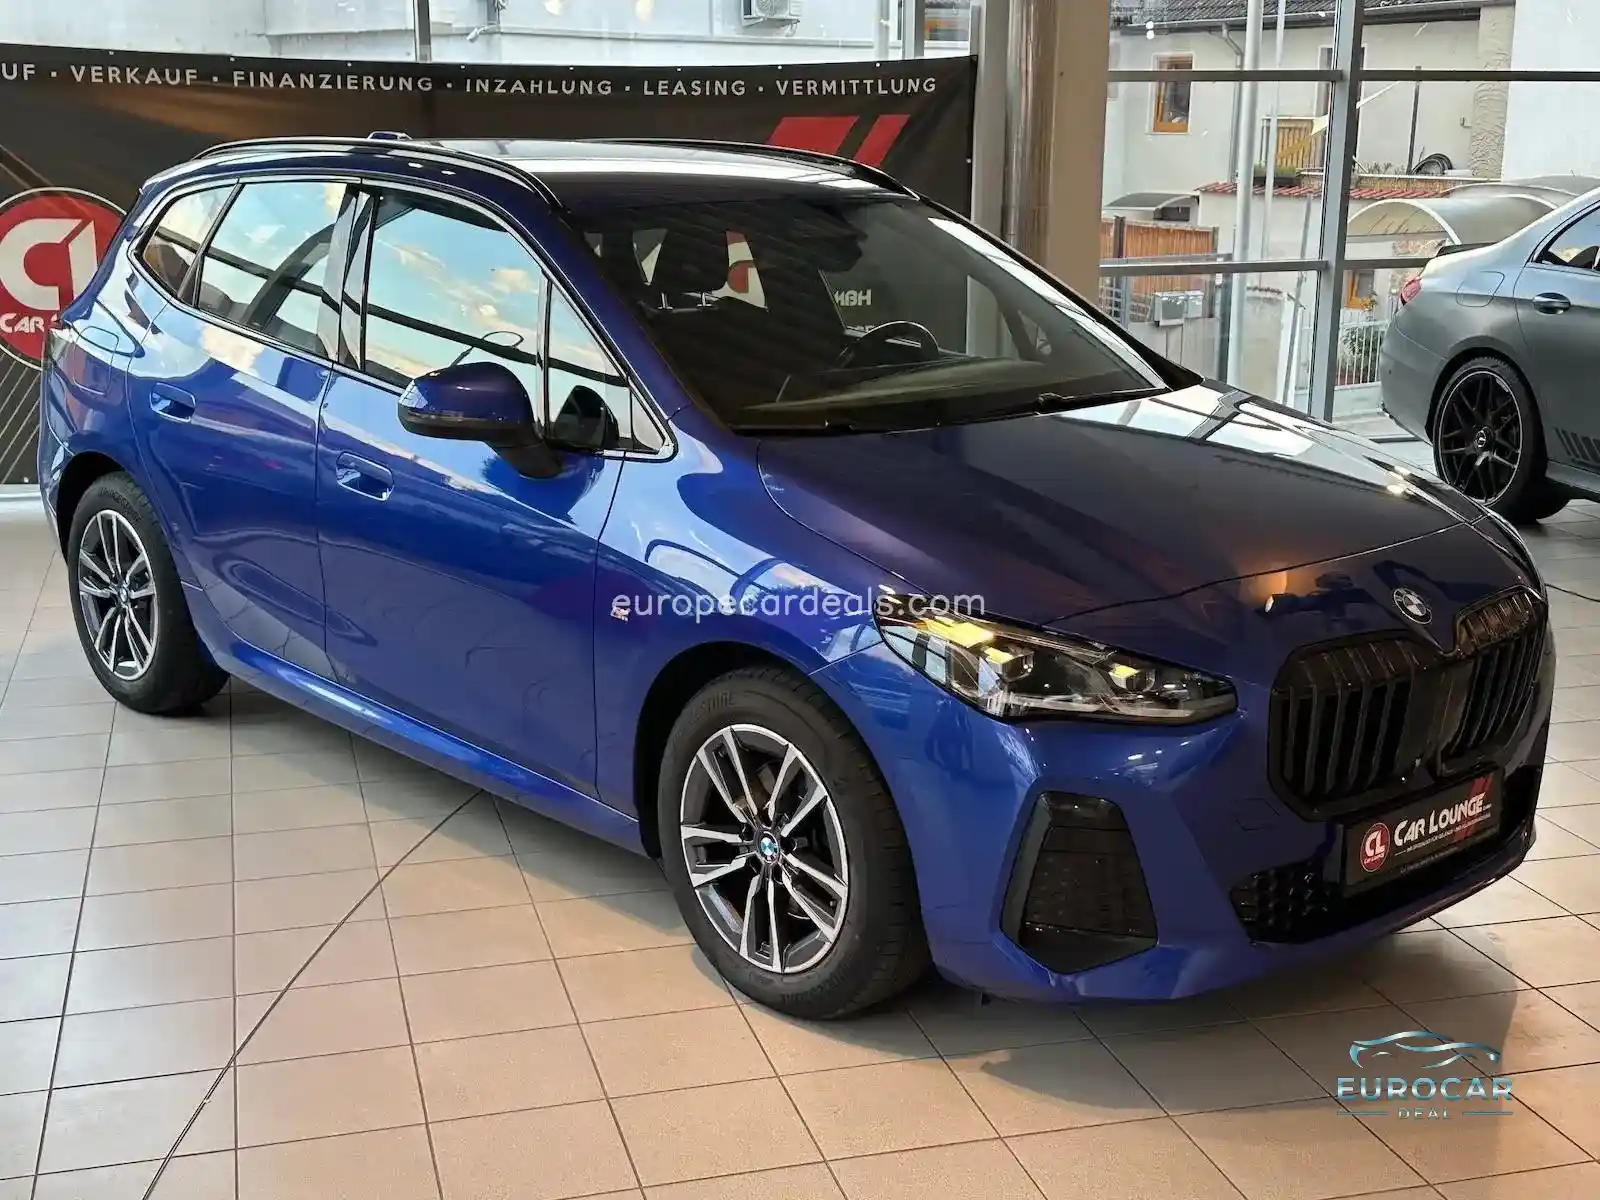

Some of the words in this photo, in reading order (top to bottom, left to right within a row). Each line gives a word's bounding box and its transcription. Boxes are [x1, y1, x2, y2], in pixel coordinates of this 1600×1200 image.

[70, 65, 198, 86] VERKAUF
[232, 71, 434, 92] FINANZIERUNG
[466, 78, 613, 96] INZAHLUNG
[643, 79, 747, 97] LEASING
[775, 76, 937, 97] VERMITTLUNG
[0, 312, 45, 334] CAR
[1394, 819, 1425, 847] CAR
[1429, 792, 1486, 834] LOUNGE
